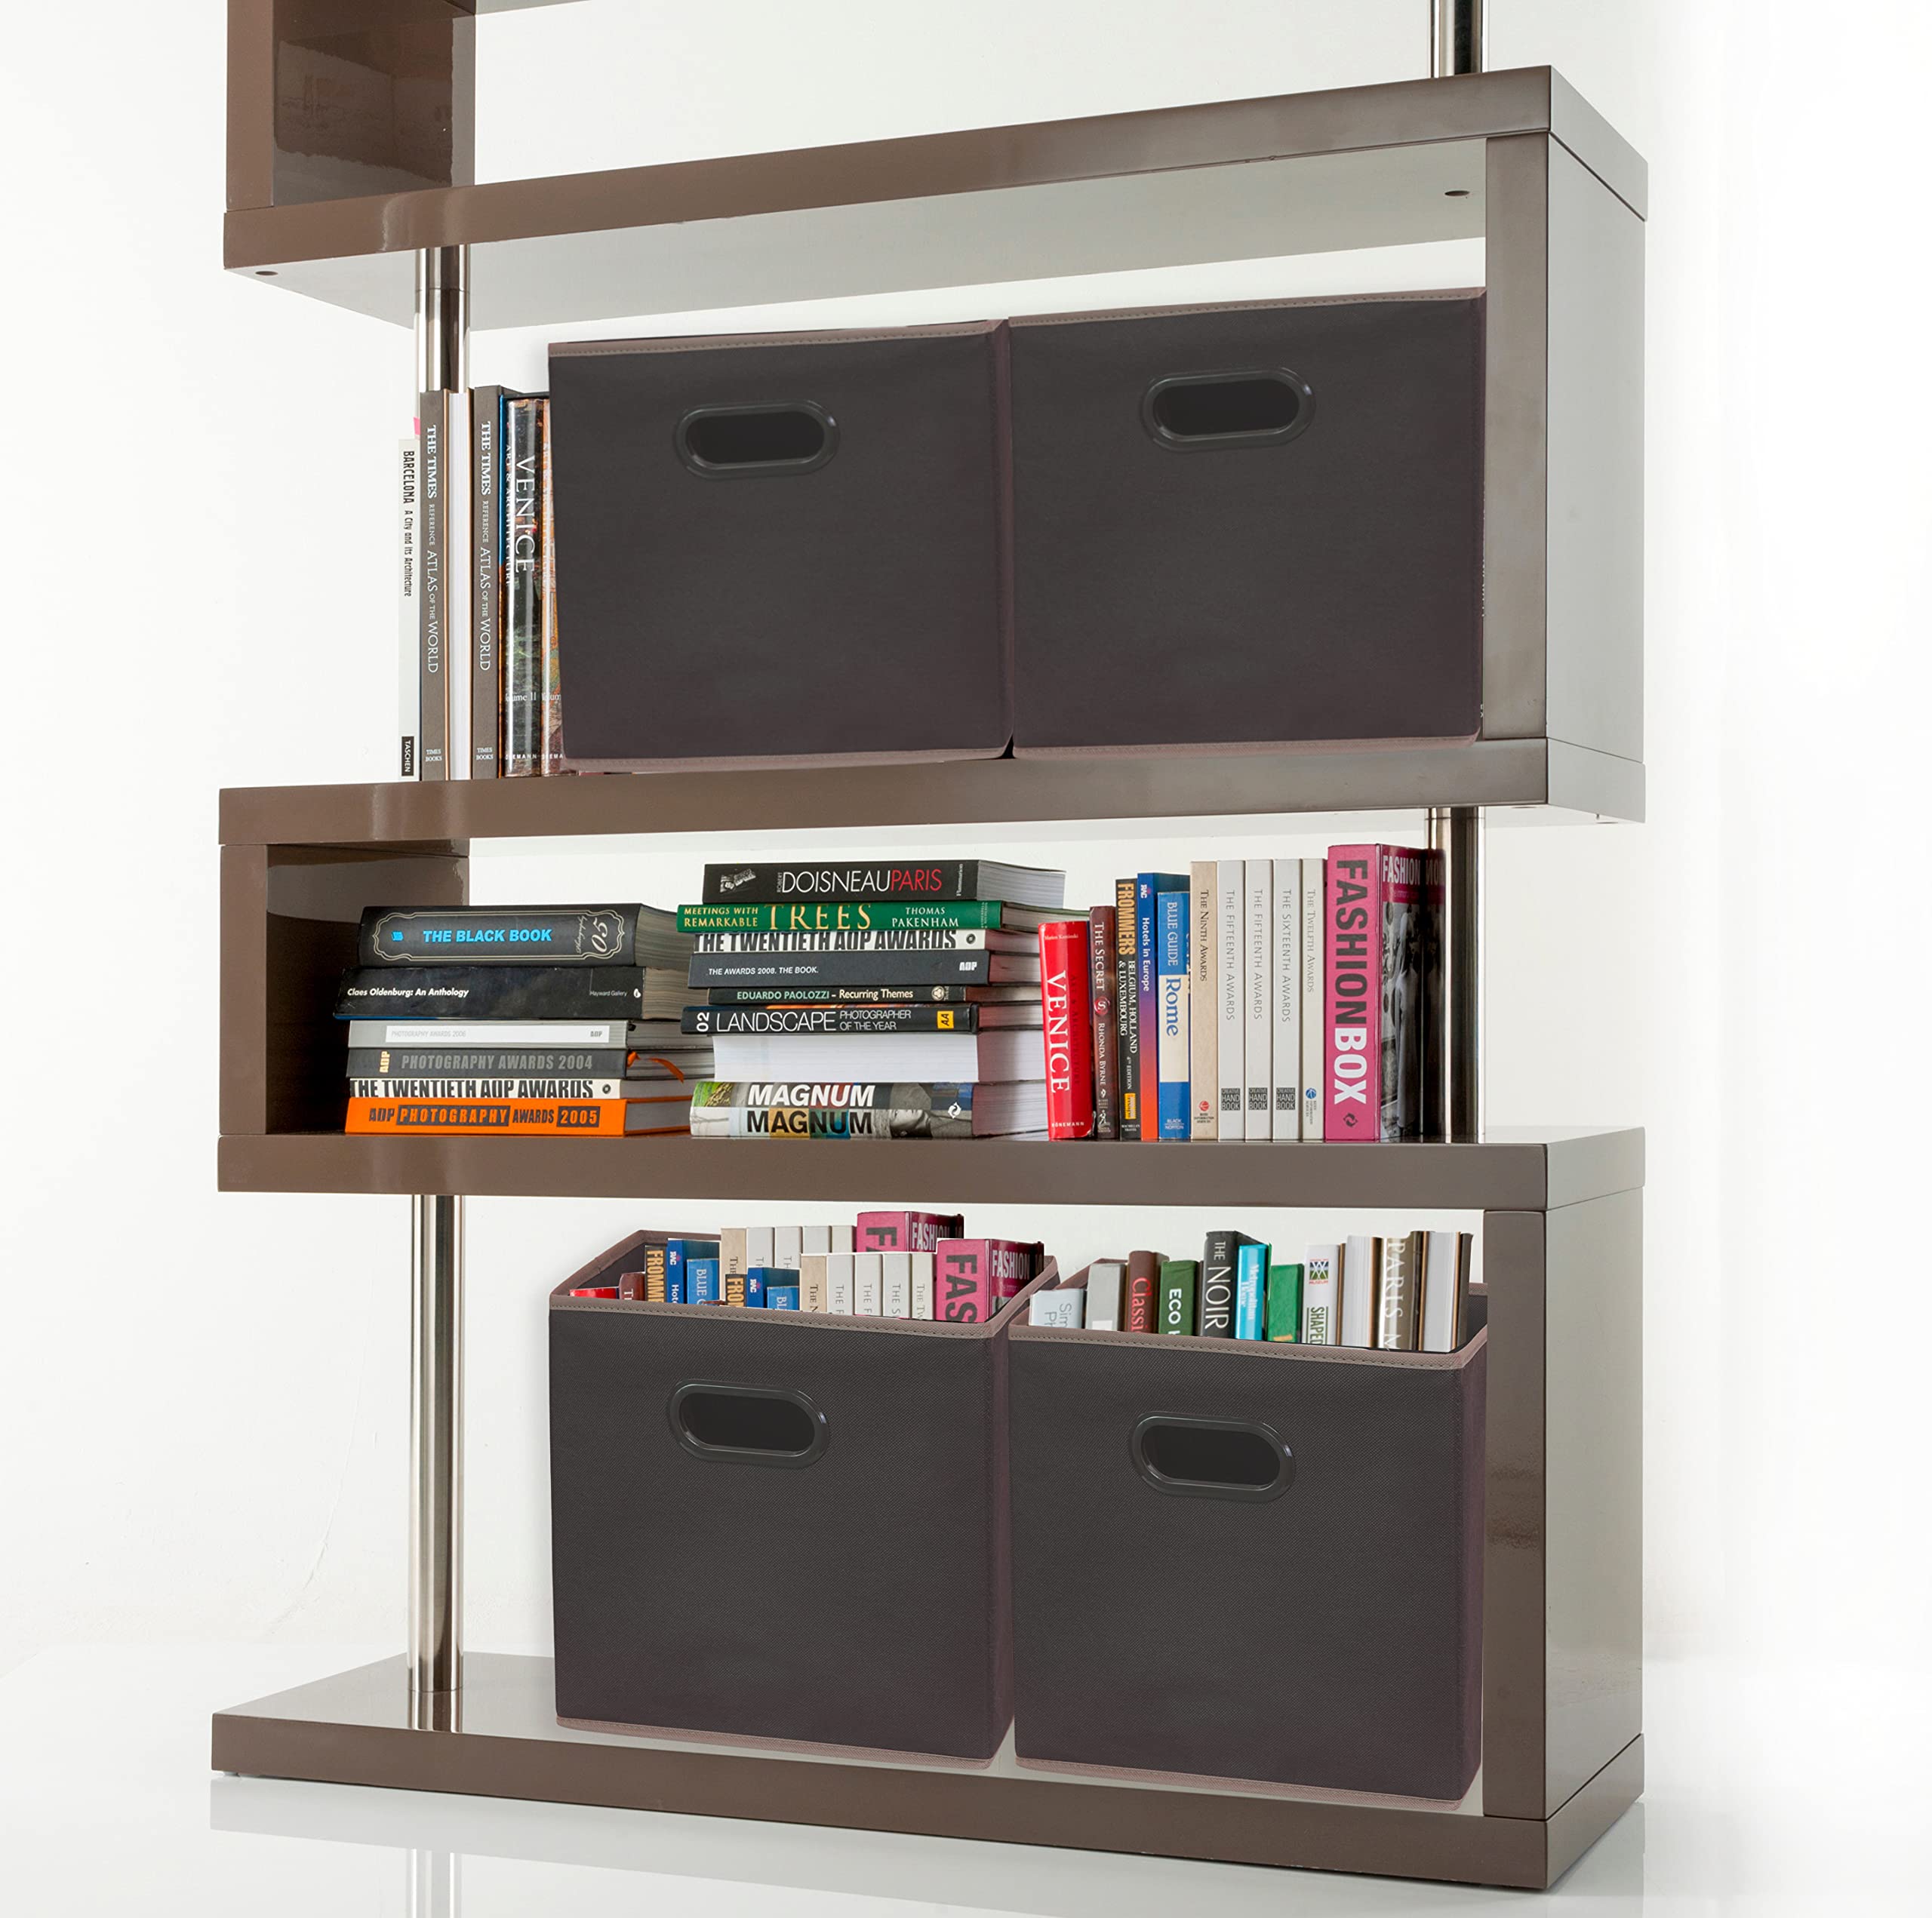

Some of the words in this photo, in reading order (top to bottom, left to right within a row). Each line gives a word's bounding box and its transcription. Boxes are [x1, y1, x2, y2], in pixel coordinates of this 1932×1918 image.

[427, 425, 436, 454] THE
[481, 421, 491, 450] THE
[403, 451, 415, 504] BARCELONA
[427, 456, 437, 499] TIMES
[481, 452, 491, 496] TIMES
[404, 518, 413, 530] City
[515, 455, 536, 573] VENICE
[405, 533, 413, 544] and
[405, 558, 413, 597] Architecture
[427, 550, 438, 592] ATLAS
[480, 547, 491, 589] ATLAS
[429, 593, 435, 604] OF
[482, 591, 488, 601] OF
[428, 620, 438, 673] WORLD
[480, 617, 491, 671] WORLD
[1383, 856, 1420, 885] FASHION
[684, 907, 730, 915] MEETINGS
[734, 907, 758, 915] WITH
[905, 907, 946, 915] THOMAS
[1200, 890, 1209, 908] THE
[1226, 890, 1235, 911] THE
[1254, 889, 1263, 910] THE
[1282, 890, 1291, 911] THE
[684, 918, 758, 927] REMARKABLE
[764, 902, 872, 930] TREES
[891, 918, 959, 928] PAKENHAM
[1118, 883, 1136, 955] FROMMERS
[1167, 902, 1177, 929] BLUE
[1200, 911, 1209, 942] NINTH
[423, 930, 451, 942] THE
[456, 930, 506, 942] BLACK
[509, 929, 552, 942] BOOK
[592, 917, 608, 953] 05
[694, 933, 724, 952] THE
[728, 932, 828, 951] TWENTIETH
[874, 930, 956, 949] AWARDS
[1095, 922, 1104, 945] THE
[1142, 918, 1150, 946] Hotels
[1226, 914, 1235, 969] FIFTEENTH
[1254, 914, 1263, 968] FIFTEENTH
[1282, 914, 1291, 970] SIXTEENTH
[1143, 948, 1150, 957] in
[1168, 932, 1178, 967] GUIDE
[1200, 944, 1209, 982] AWARDS
[795, 966, 819, 974] BOOK.
[1095, 948, 1105, 991] SECRET
[1128, 961, 1137, 1006] BELGIUM,
[1141, 960, 1151, 991] Europe
[347, 988, 368, 996] Claes
[369, 988, 414, 998] Oldenburg:
[415, 988, 426, 996] An
[428, 988, 469, 998] Anthology
[737, 991, 781, 1000] EDUARDO
[783, 991, 829, 1000] PAOLOZZI
[838, 989, 878, 1000] Recurring
[880, 988, 913, 999] Themes
[1119, 971, 1128, 1036] LUXEMBOURG
[1226, 973, 1235, 1020] AWARDS
[1254, 973, 1263, 1019] AWARDS
[1282, 976, 1291, 1022] AWARDS
[716, 1011, 836, 1032] LANDSCAPE
[839, 1010, 911, 1019] PHOTOGRAPHER
[940, 1013, 949, 1027] AA
[1166, 978, 1181, 1037] Rome
[696, 1012, 710, 1032] 02
[839, 1022, 851, 1031] OF
[854, 1021, 872, 1031] THE
[873, 1021, 897, 1030] YEAR
[1048, 970, 1070, 1093] VENICE
[1129, 1007, 1137, 1053] HOLLAND
[401, 1055, 494, 1069] PHOTOGRAPHY
[497, 1055, 554, 1069] AWARDS
[558, 1055, 592, 1069] 2004
[350, 1080, 378, 1098] THE
[381, 1080, 480, 1098] TWENTIETH
[517, 1080, 594, 1098] AWARDS
[747, 1084, 875, 1107] MAGNUM
[399, 1108, 508, 1123] PHOTOGRAPHY
[512, 1108, 554, 1123] AWARDS
[561, 1109, 598, 1124] 2005
[747, 1111, 873, 1133] MAGNUM
[992, 1249, 1030, 1280] FASHION
[1214, 1241, 1226, 1261] THE
[696, 1268, 707, 1296] BLUE
[835, 1284, 844, 1304] THE
[863, 1283, 872, 1303] THE
[892, 1283, 901, 1303] THE
[1386, 1243, 1406, 1317] PARIS
[1131, 1277, 1152, 1332] Classi
[1168, 1288, 1182, 1324] ECO
[1204, 1267, 1231, 1329] NOIR
